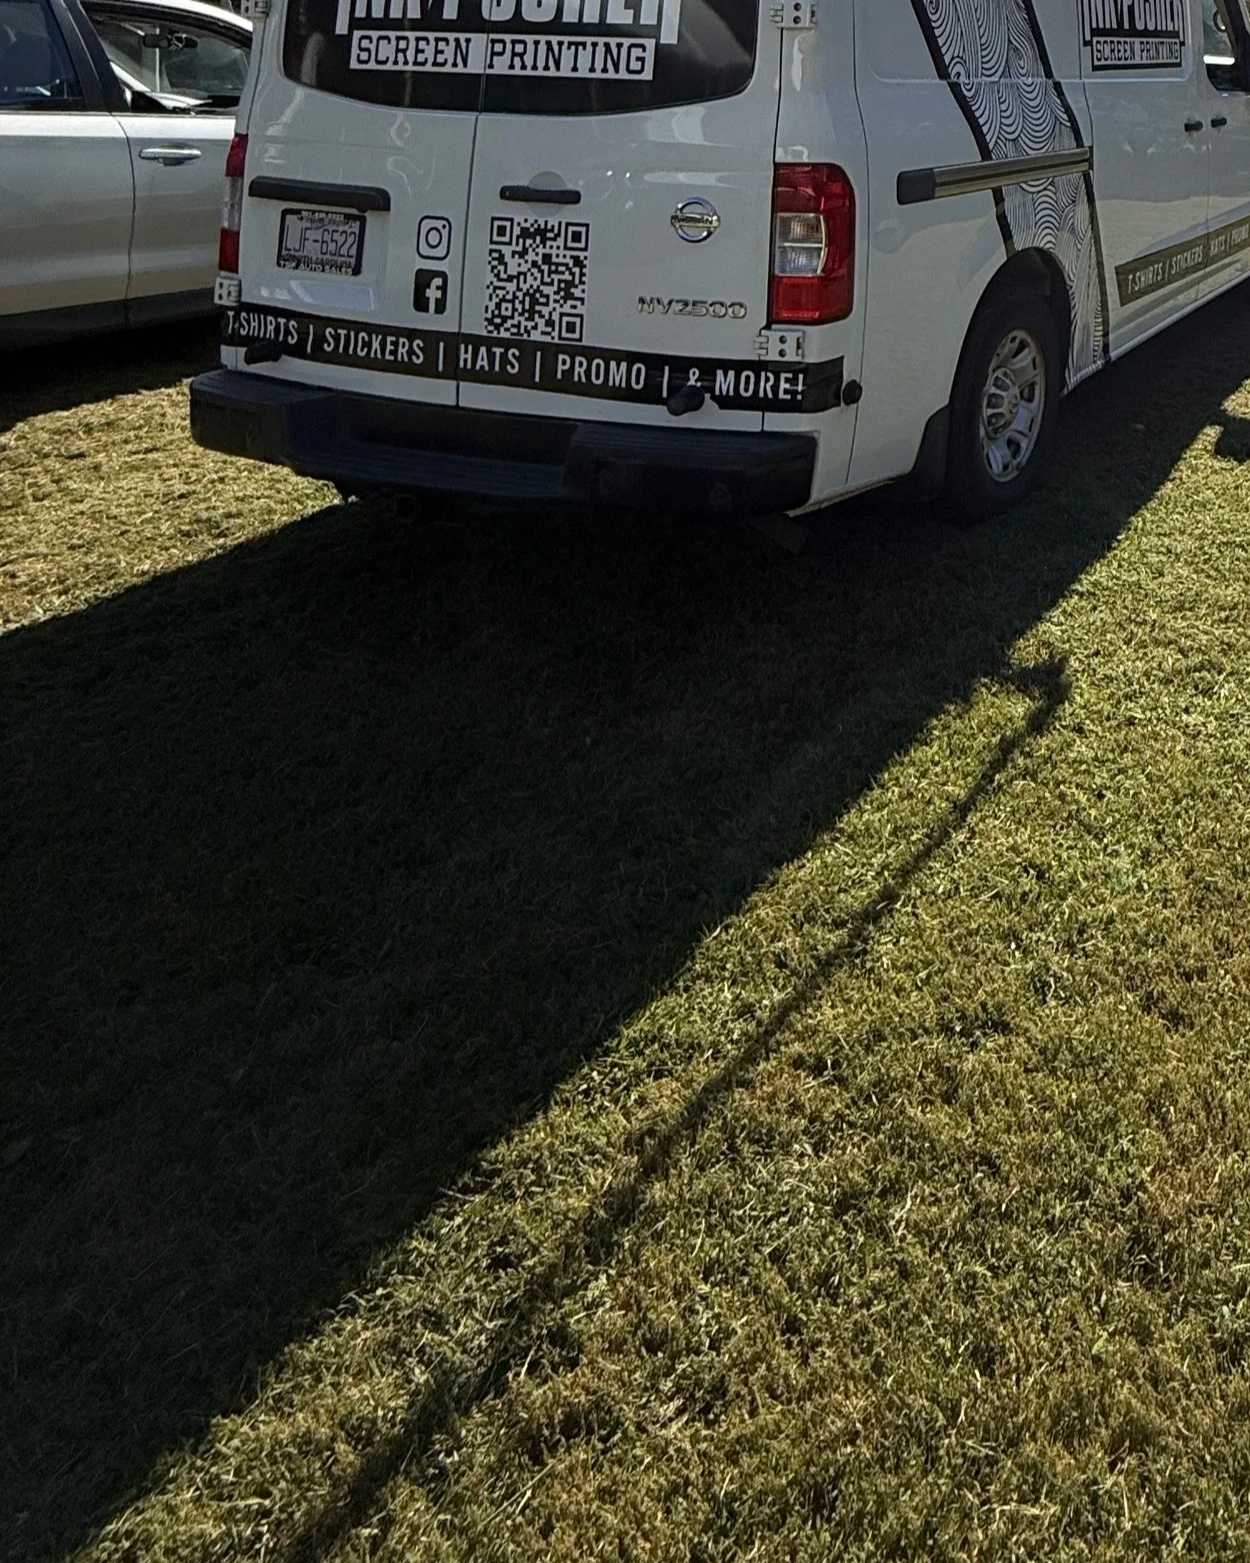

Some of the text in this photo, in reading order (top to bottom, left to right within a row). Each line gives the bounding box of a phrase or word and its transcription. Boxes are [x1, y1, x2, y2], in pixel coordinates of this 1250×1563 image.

[356, 34, 648, 76] SCREEN PRINTING
[1095, 40, 1179, 62] SCREEN PRINTING
[284, 224, 357, 259] LJF-6522
[299, 262, 323, 272] AUTO
[324, 264, 353, 276] SALES
[1171, 244, 1204, 275] STICKERS
[638, 296, 748, 319] NV2500
[324, 327, 425, 365] STICKERS
[459, 344, 520, 375] HATS
[556, 353, 646, 390] PROMO
[714, 369, 804, 401] MORE!
